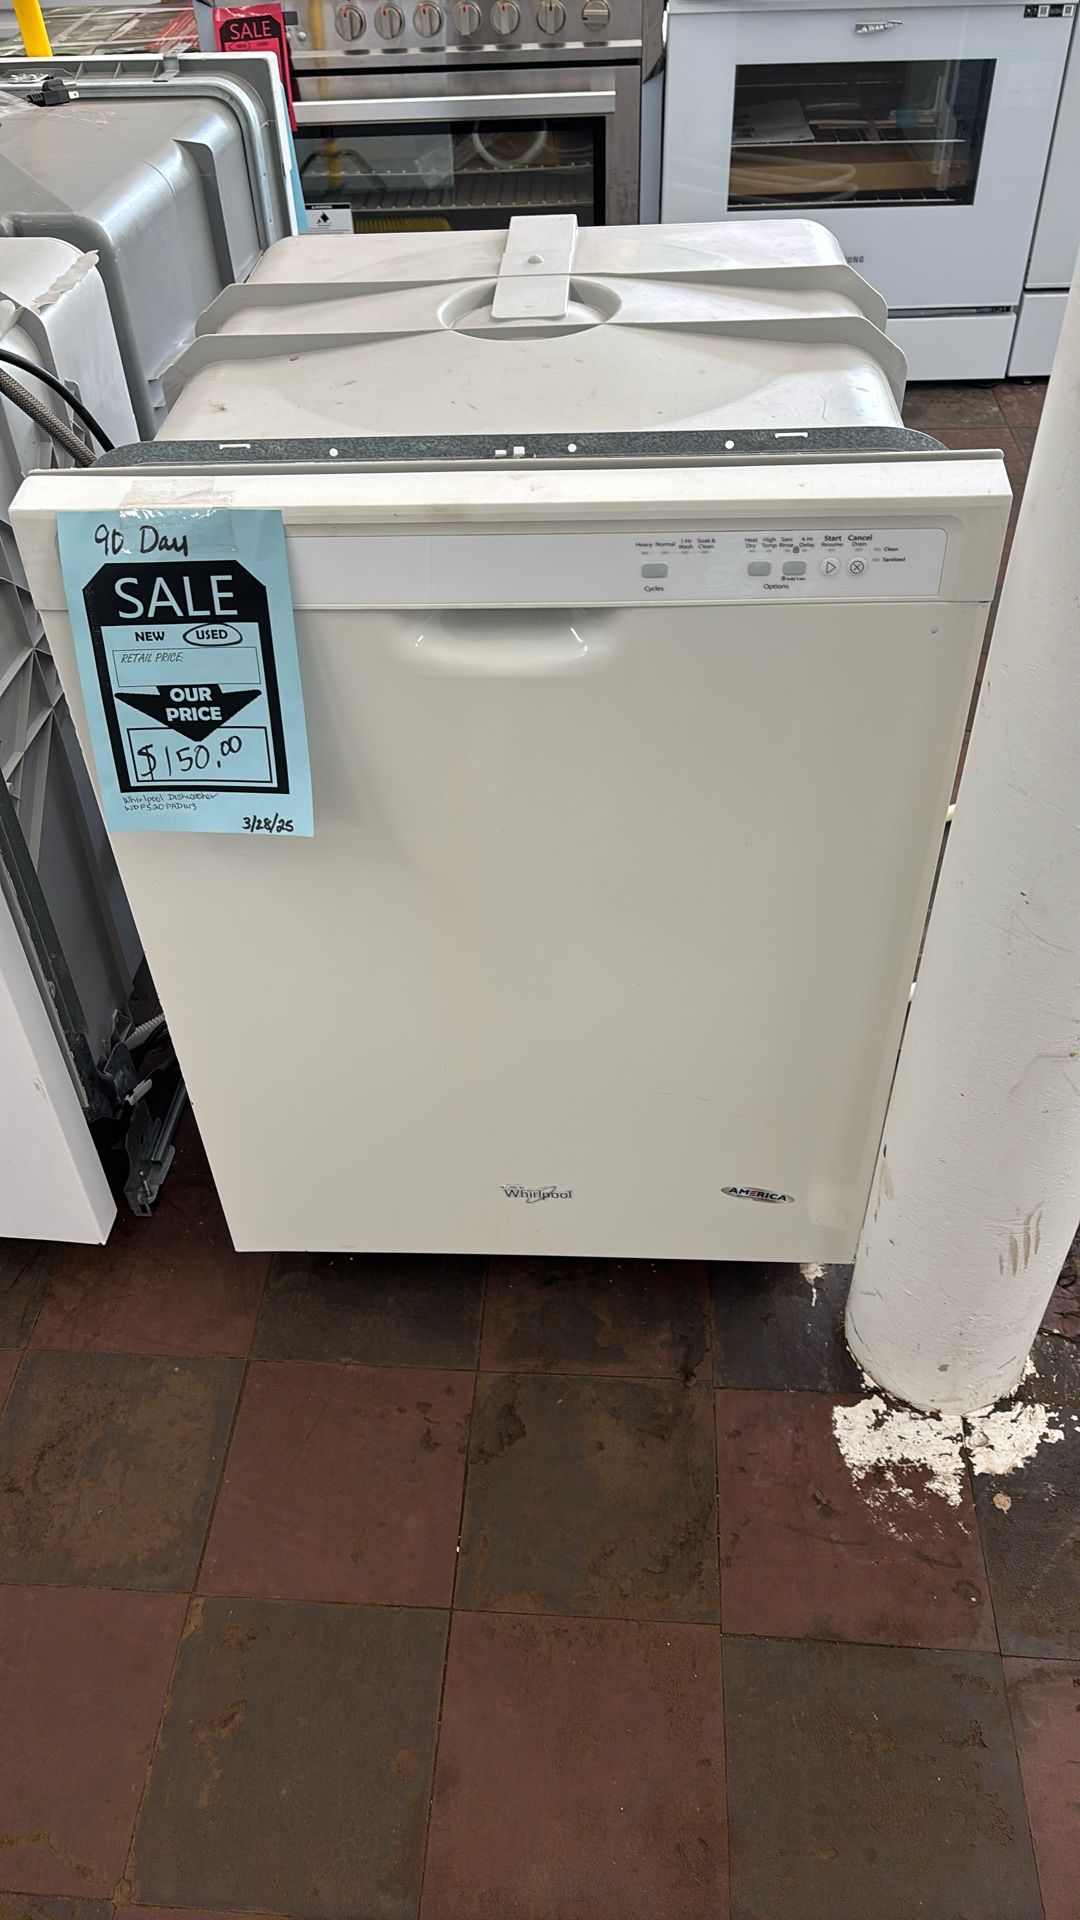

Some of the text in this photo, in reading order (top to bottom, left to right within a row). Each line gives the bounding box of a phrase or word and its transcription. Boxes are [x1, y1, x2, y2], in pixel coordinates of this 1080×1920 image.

[229, 20, 272, 40] SALE
[94, 523, 189, 557] 90 Day
[761, 543, 777, 551] Temp
[644, 585, 664, 593] Cycles
[763, 583, 789, 591] Options
[114, 574, 239, 619] SALE
[135, 629, 228, 642] NEW USED
[121, 651, 184, 664] RETAIL PRICE:
[169, 687, 213, 702] OUR
[165, 706, 222, 722] PRICE
[123, 794, 164, 804] Whirlpool
[242, 812, 294, 833] 3/28/25
[504, 1189, 572, 1201] Whirlpool
[728, 1187, 787, 1202] AMERICA
